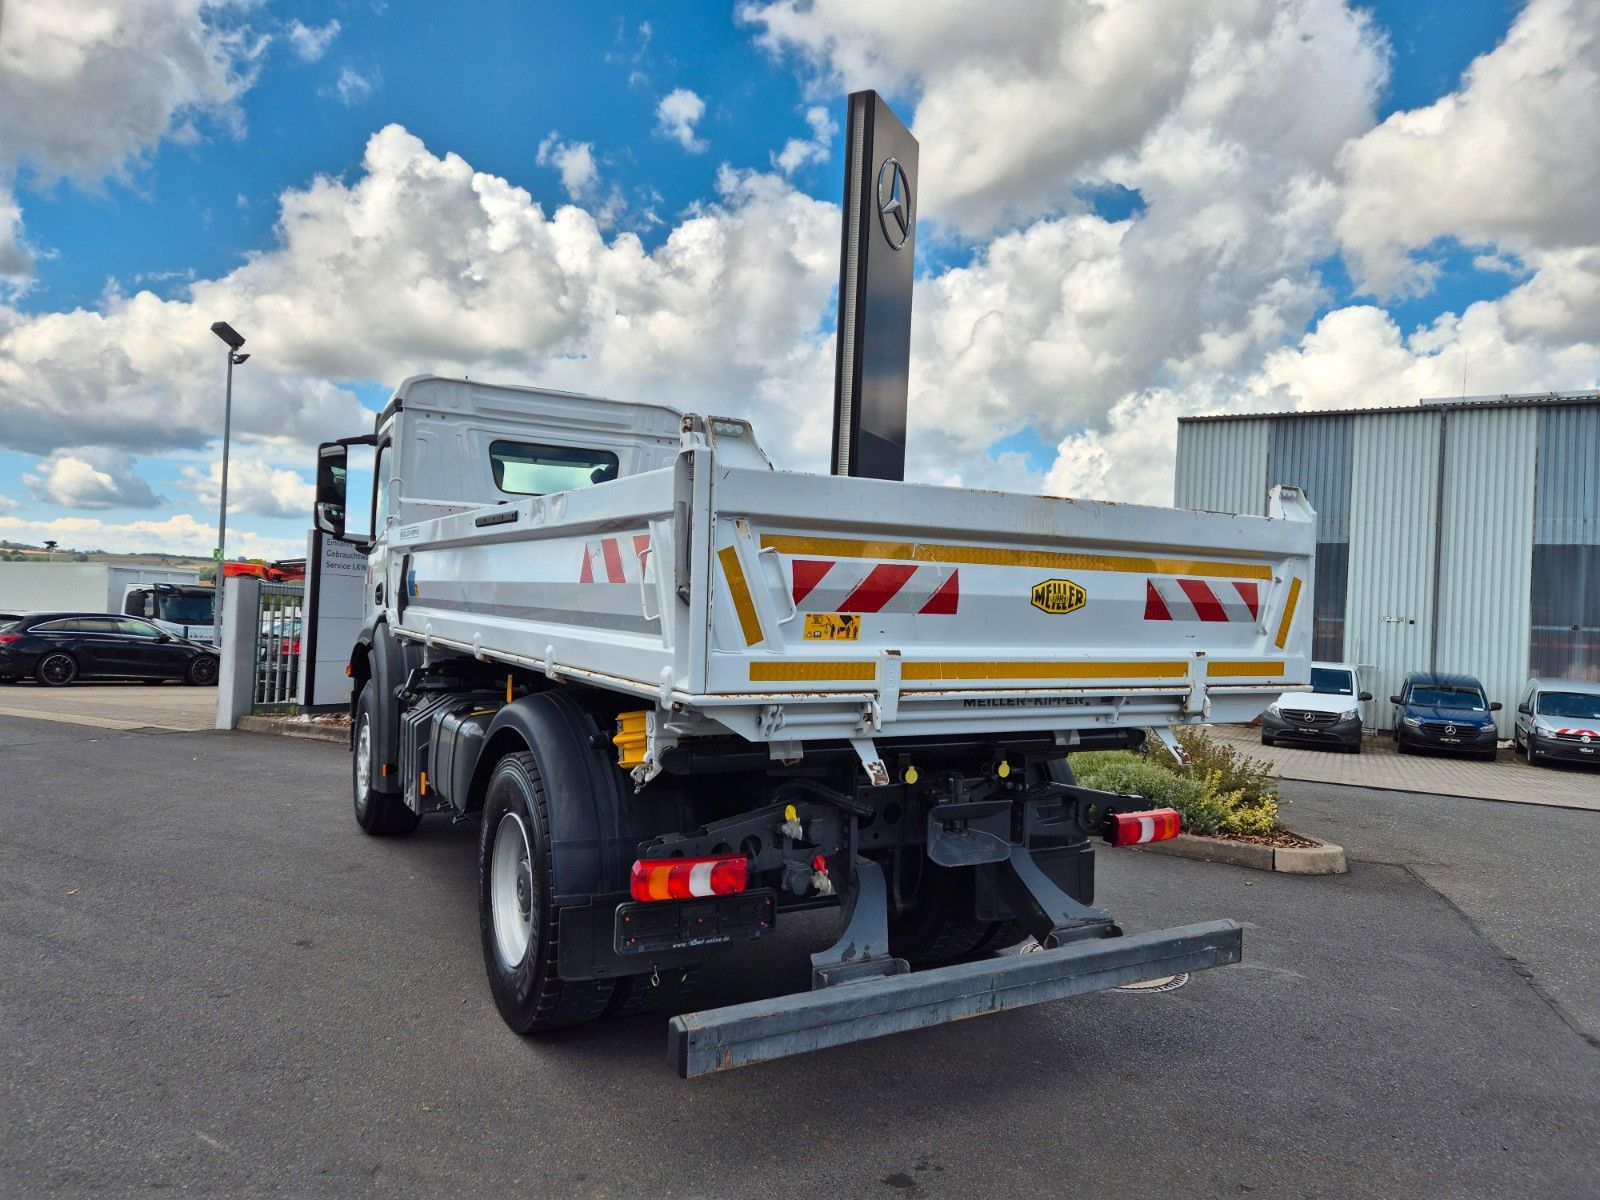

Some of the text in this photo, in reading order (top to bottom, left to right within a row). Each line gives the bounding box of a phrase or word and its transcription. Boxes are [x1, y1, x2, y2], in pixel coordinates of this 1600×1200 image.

[326, 560, 367, 572] Service LKW
[1034, 582, 1084, 610] MEILLER
